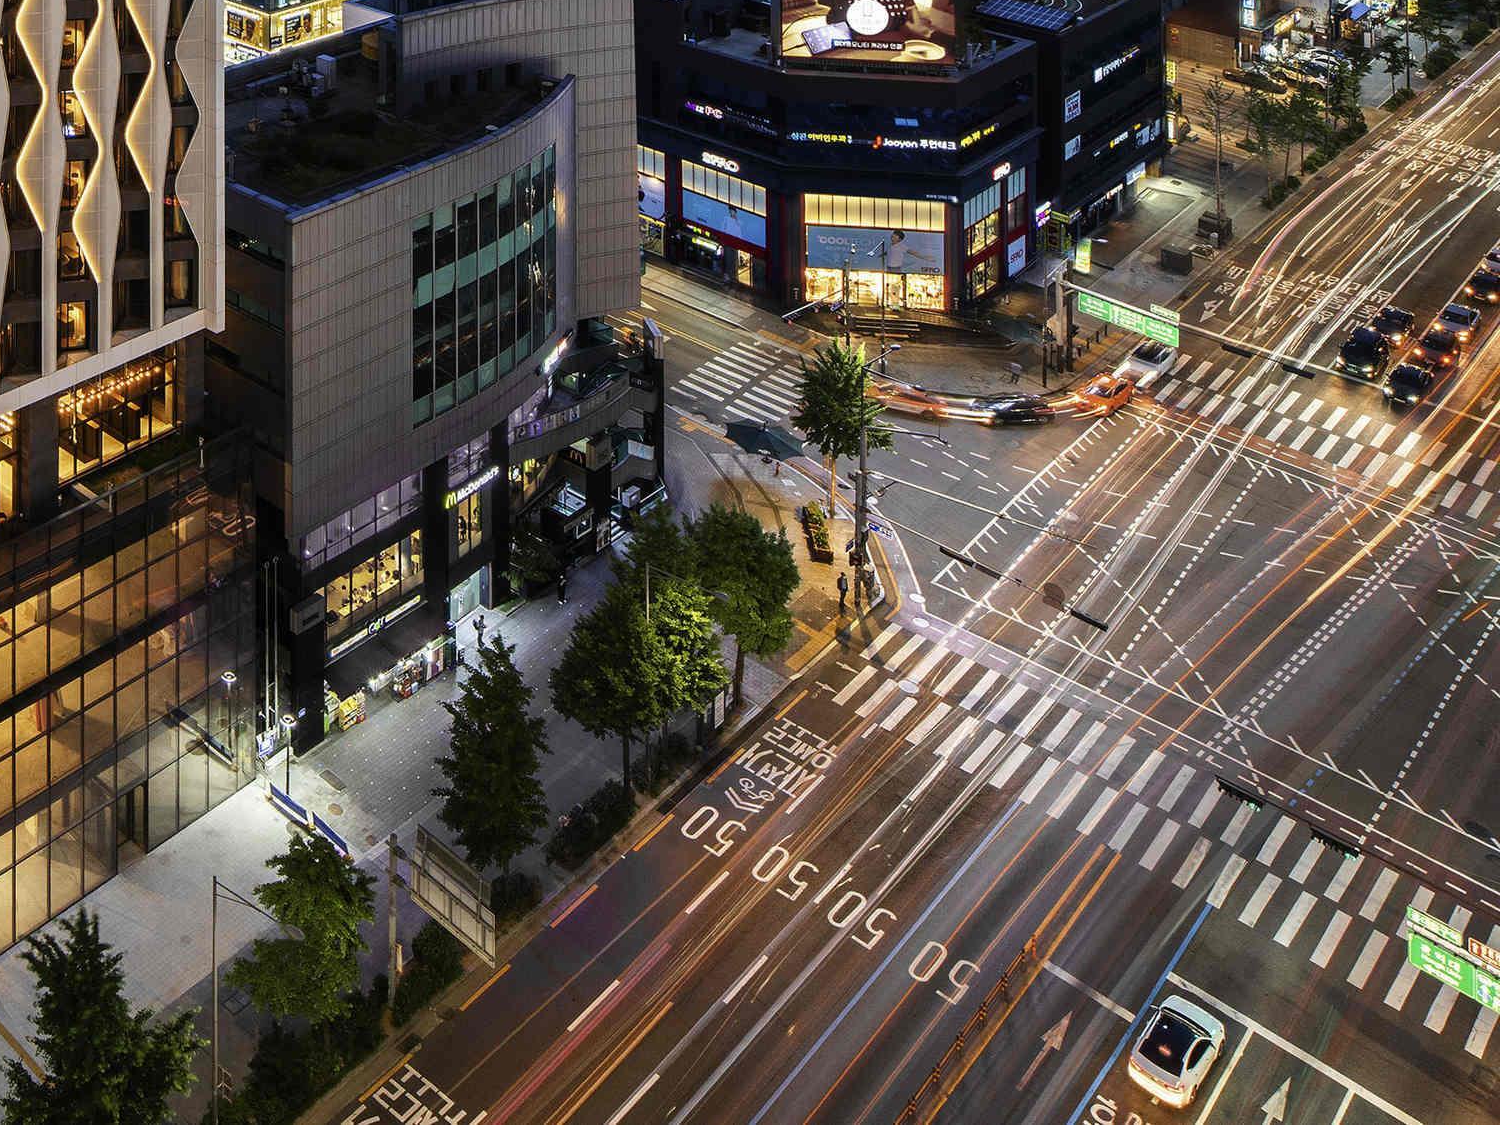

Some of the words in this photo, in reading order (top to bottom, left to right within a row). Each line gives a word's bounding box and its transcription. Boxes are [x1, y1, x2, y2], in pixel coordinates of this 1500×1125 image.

[883, 137, 918, 149] Jooyon
[920, 139, 957, 151] 주연테크
[457, 466, 499, 502] McDonald's
[681, 805, 747, 858] 50
[751, 845, 820, 902] 50
[827, 890, 898, 950] 50
[908, 940, 981, 1005] 50
